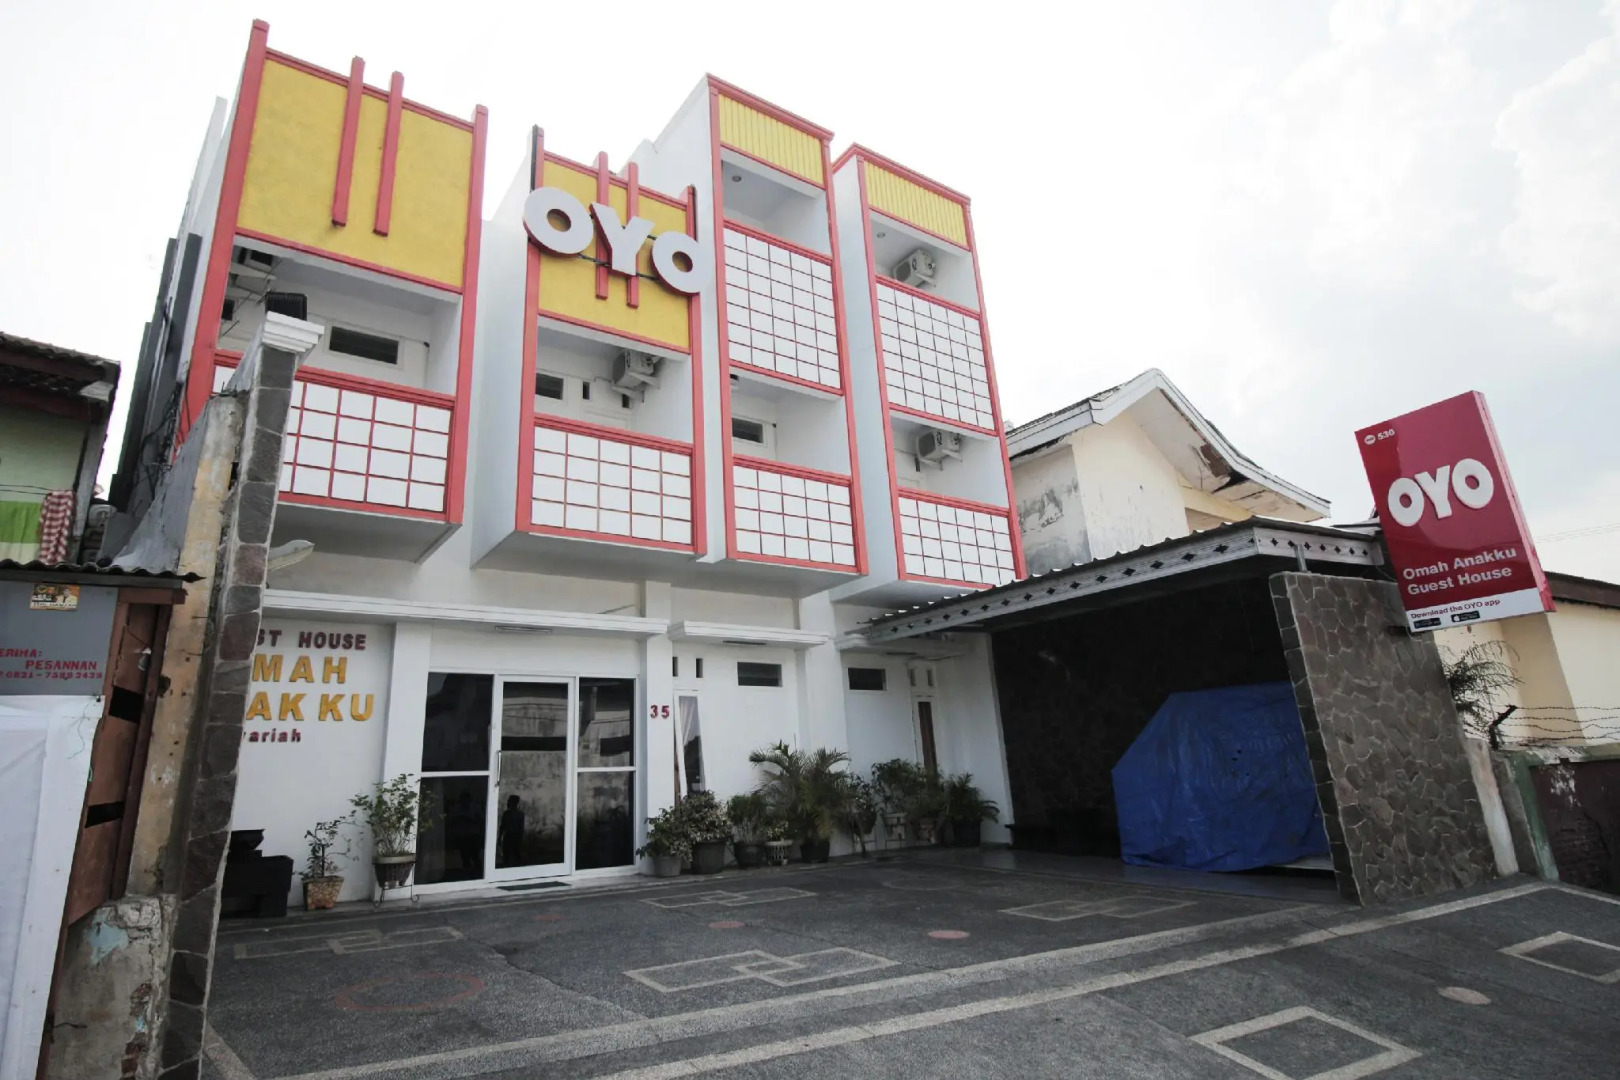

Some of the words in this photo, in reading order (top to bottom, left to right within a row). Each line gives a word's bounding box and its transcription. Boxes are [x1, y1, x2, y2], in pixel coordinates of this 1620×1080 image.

[523, 187, 711, 296] OYO
[1388, 458, 1494, 527] OYO
[1403, 562, 1449, 580] Omah
[1453, 548, 1517, 570] Anakku
[1407, 577, 1455, 595] Guest
[1457, 567, 1513, 586] House
[1411, 607, 1448, 619] Download
[1449, 605, 1463, 613] the
[1464, 601, 1483, 610] OYO
[1484, 599, 1501, 607] app
[298, 631, 367, 650] HOUSE
[252, 653, 348, 684] MAH
[650, 704, 670, 719] 35
[243, 728, 302, 742] ariah
